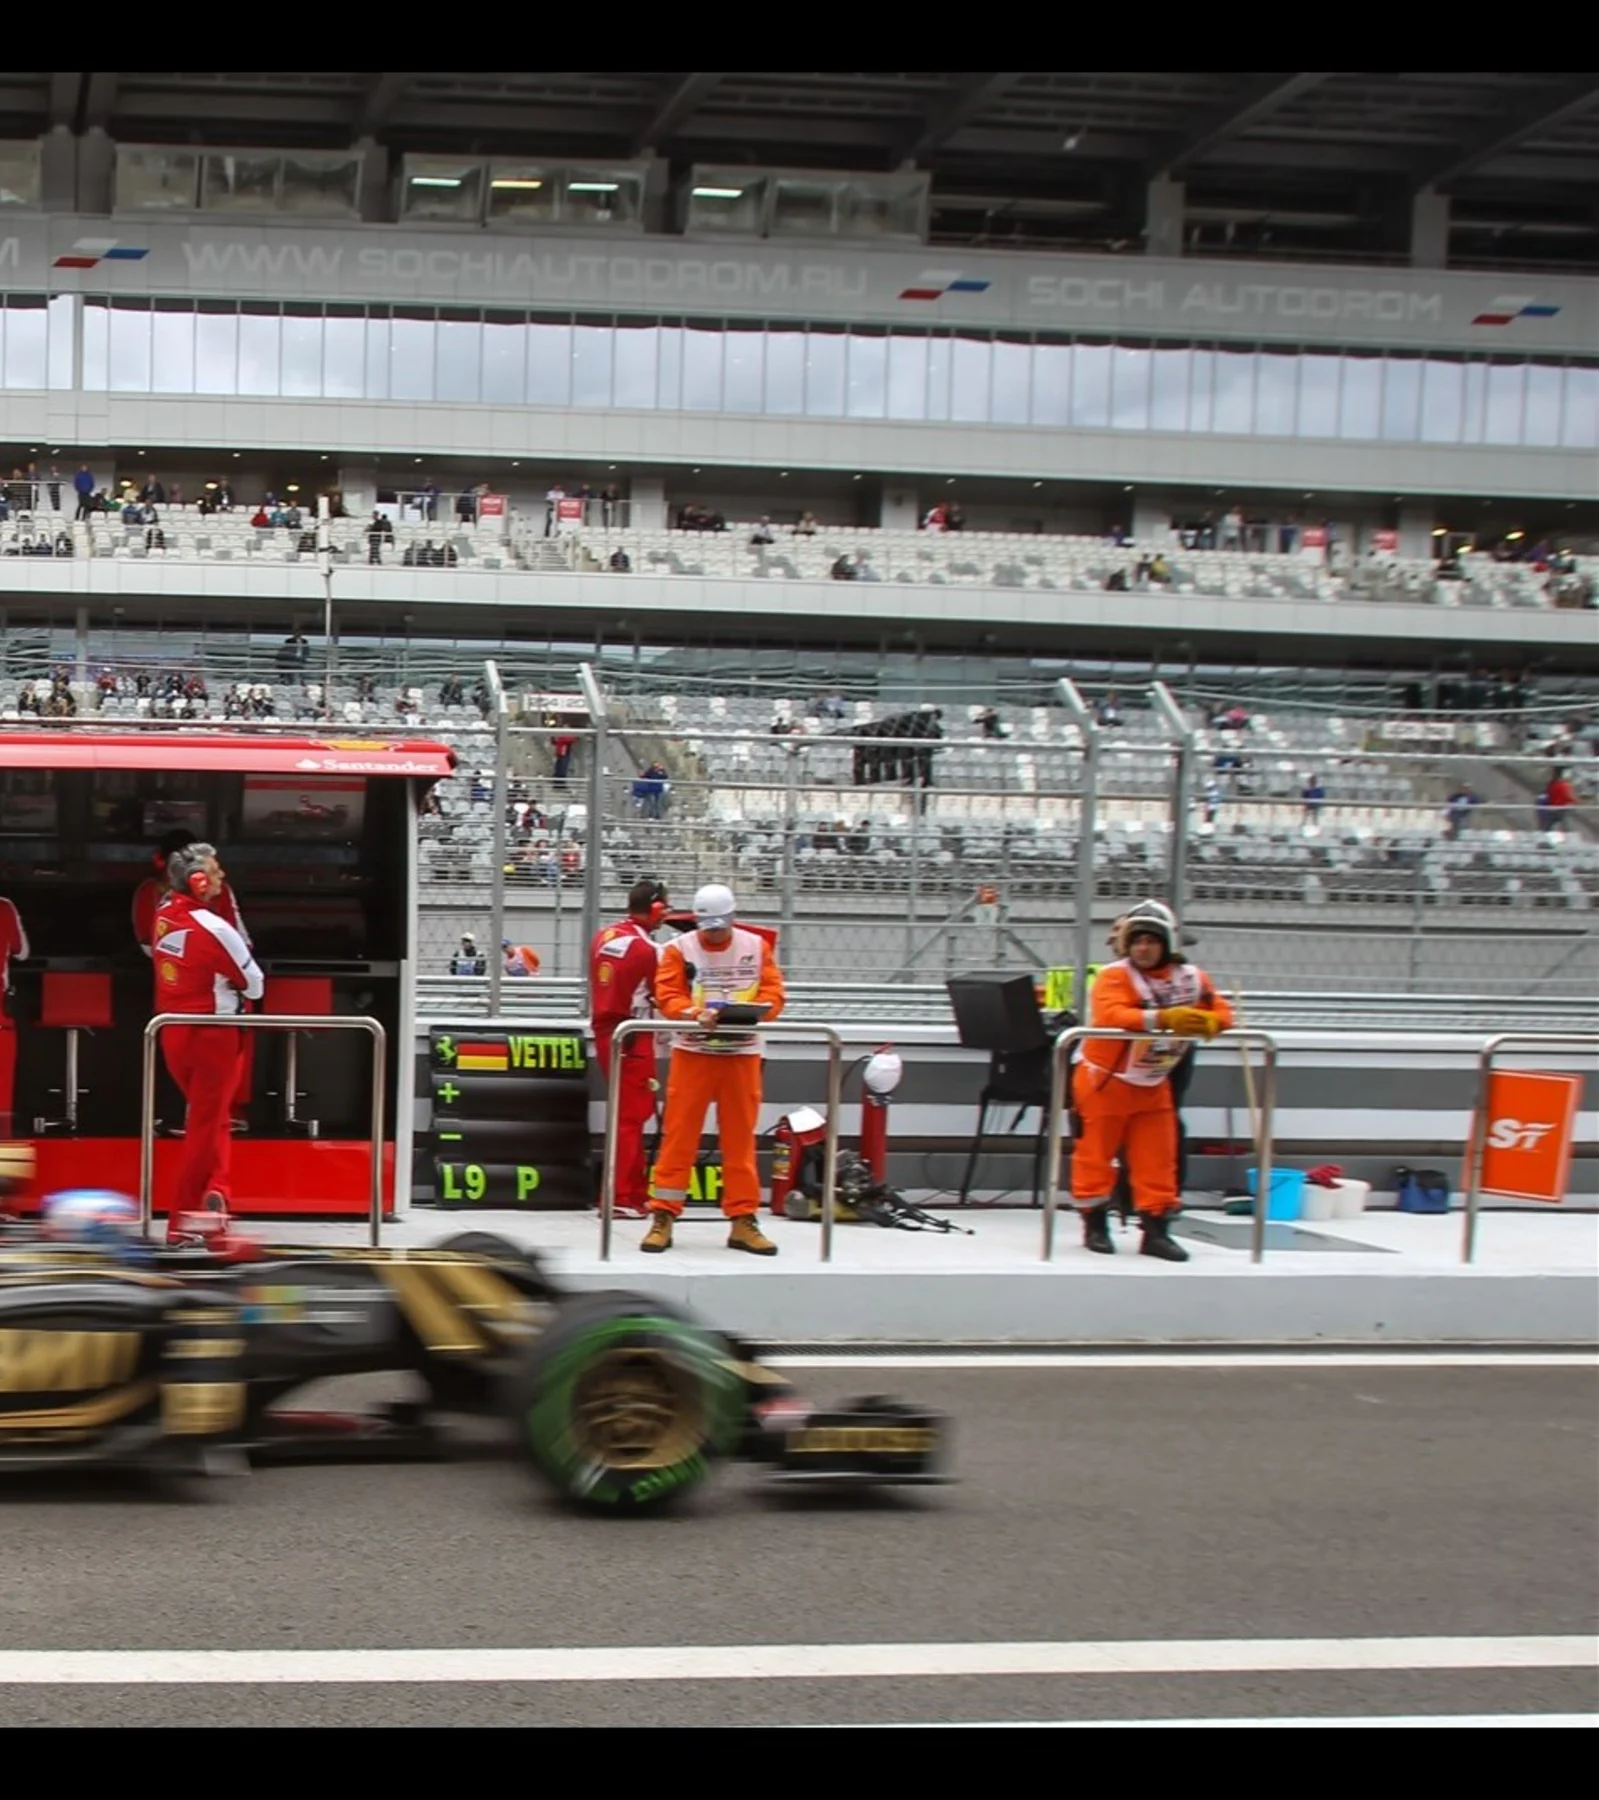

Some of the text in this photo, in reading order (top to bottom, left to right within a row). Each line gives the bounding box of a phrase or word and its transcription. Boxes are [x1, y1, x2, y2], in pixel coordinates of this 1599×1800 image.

[1027, 275, 1443, 322] SOCHI AUTODROM
[323, 759, 439, 772] Santander
[508, 1035, 585, 1070] VETTEL
[442, 1163, 541, 1201] L9 P
